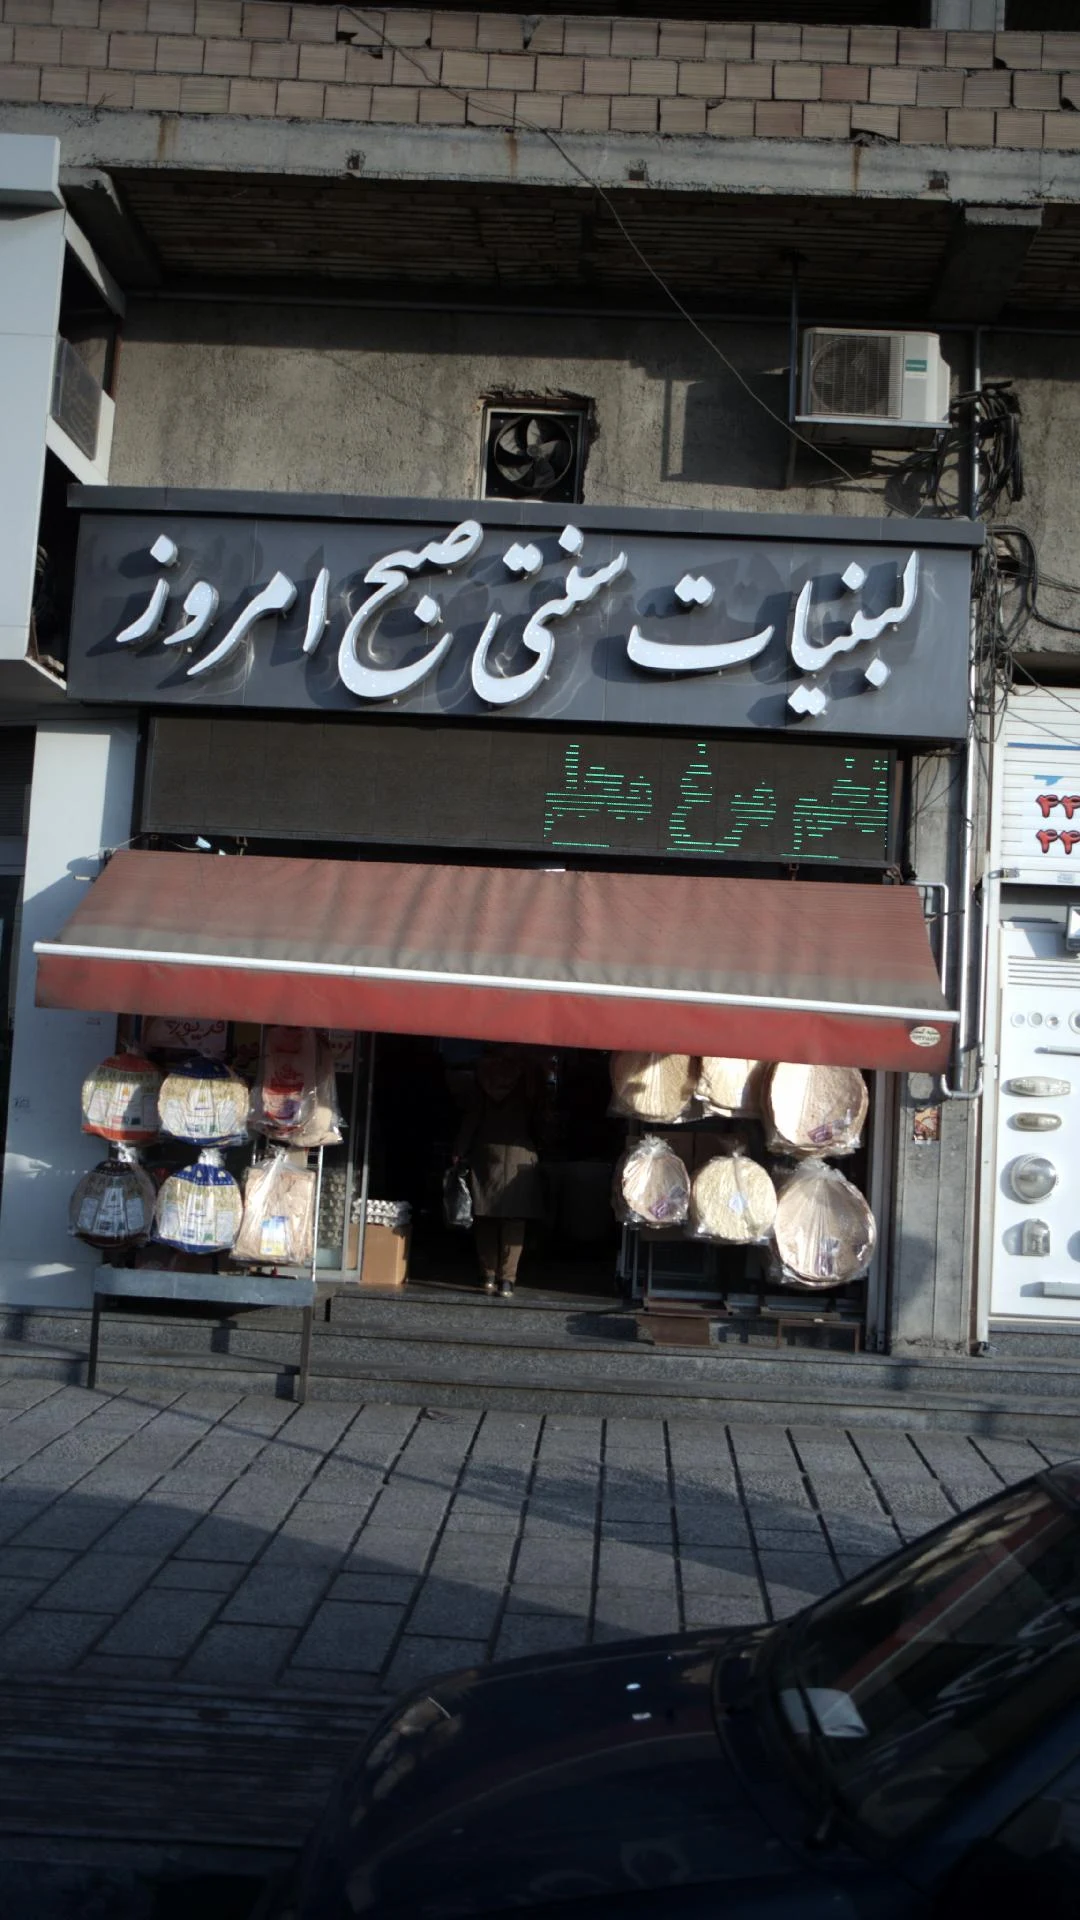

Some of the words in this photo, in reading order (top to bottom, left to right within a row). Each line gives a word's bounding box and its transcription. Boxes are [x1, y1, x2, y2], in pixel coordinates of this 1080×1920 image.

[115, 534, 330, 677] امروز
[337, 519, 485, 700] صبح
[471, 524, 629, 706] سنتی
[626, 550, 919, 717] لبنیات
